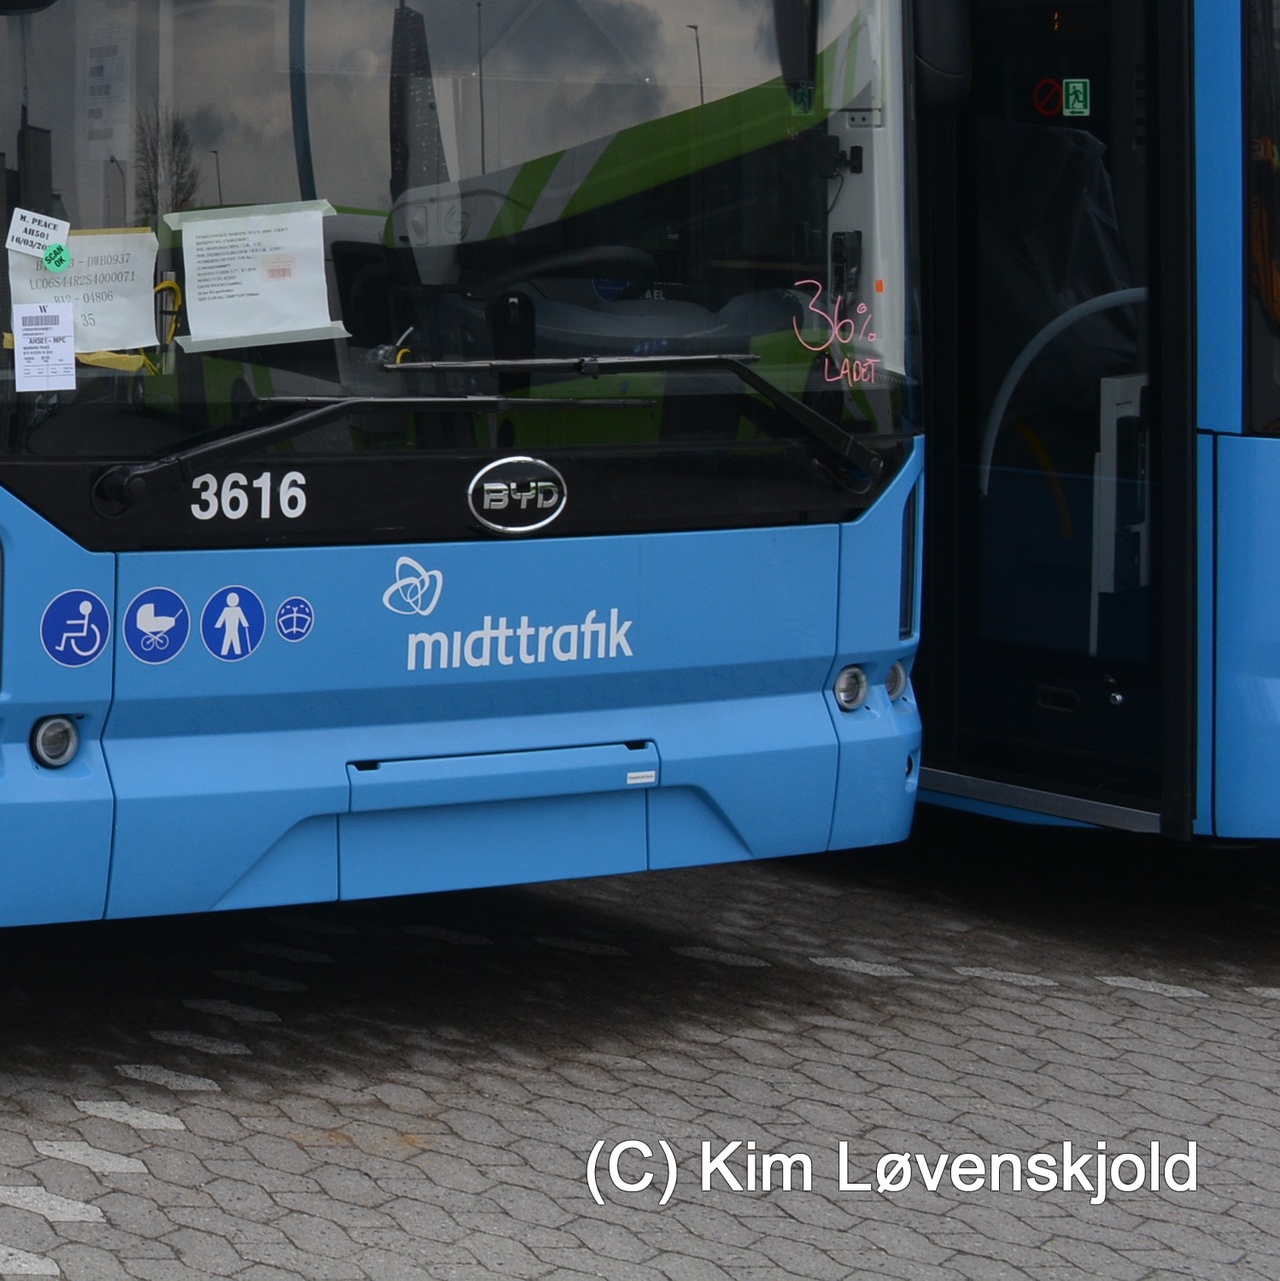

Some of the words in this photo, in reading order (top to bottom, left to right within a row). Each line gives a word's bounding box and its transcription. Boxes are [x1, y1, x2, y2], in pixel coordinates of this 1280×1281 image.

[19, 214, 29, 223] M.
[31, 217, 59, 231] PEACE
[22, 227, 49, 240] AH501
[44, 245, 64, 264] SCAN
[54, 256, 66, 268] OK
[81, 313, 96, 327] 35
[792, 279, 877, 351] 36%
[190, 471, 307, 521] 3616
[482, 481, 559, 511] BYD
[407, 608, 634, 672] midttrafik
